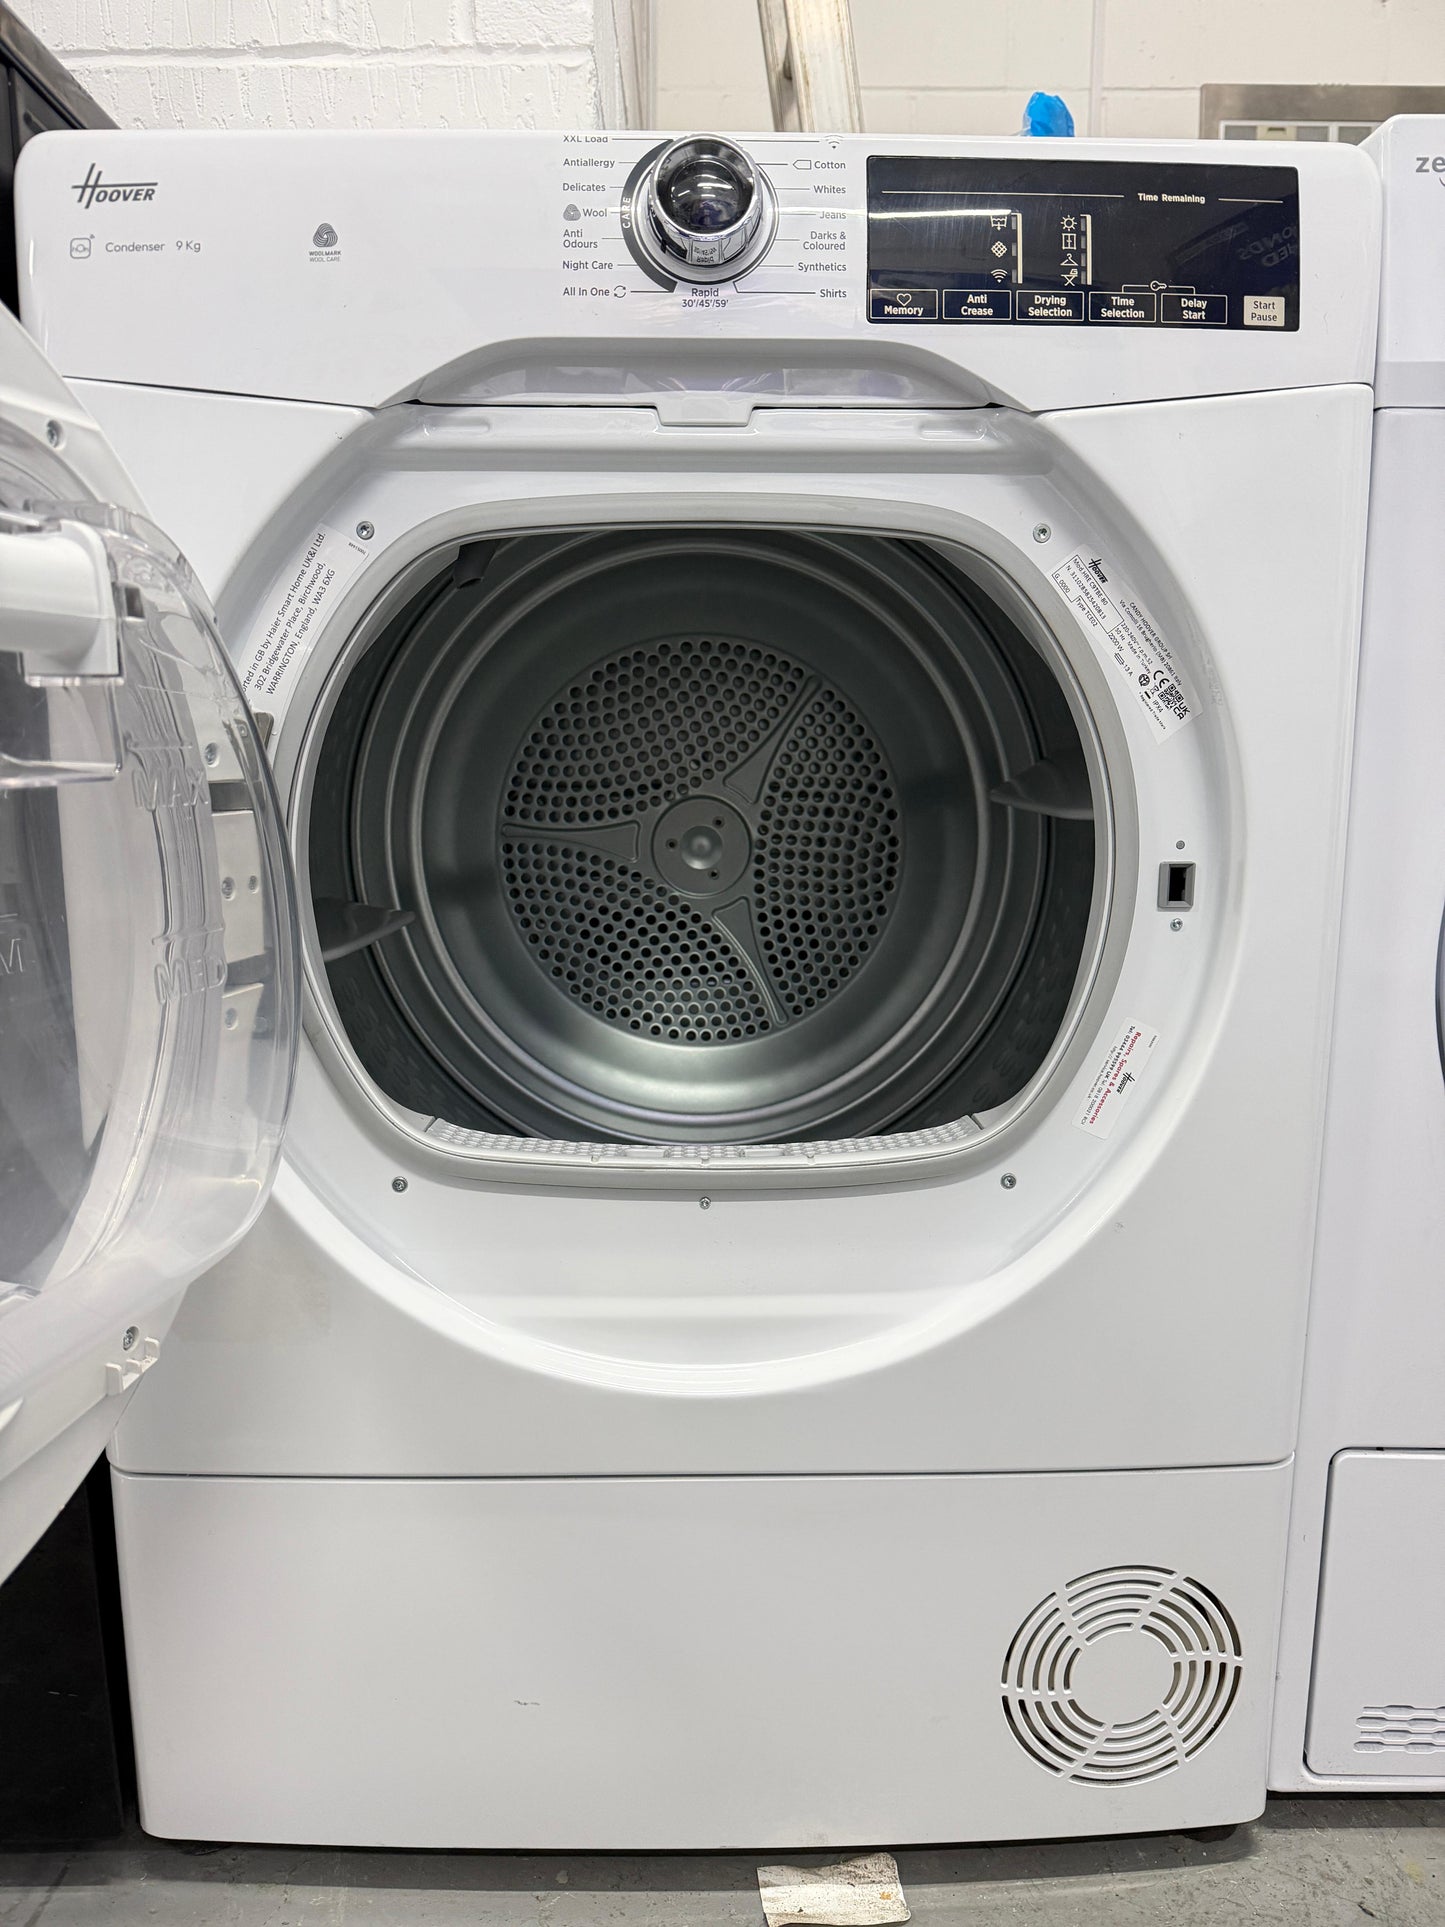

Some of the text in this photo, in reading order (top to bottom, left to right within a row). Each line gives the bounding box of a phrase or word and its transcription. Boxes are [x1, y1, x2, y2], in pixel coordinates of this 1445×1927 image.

[563, 134, 609, 143] XXL Load
[563, 157, 615, 169] Antiallergy
[814, 160, 846, 170] Cotton
[71, 163, 158, 209] HOOVER
[562, 182, 606, 193] Delicates
[813, 184, 846, 195] Whites
[1138, 192, 1206, 205] Time Remaining
[582, 207, 608, 218] Wool
[621, 196, 631, 229] CARE
[819, 210, 847, 220] Jeans
[563, 229, 583, 239] Anti
[810, 230, 847, 240] Darks &
[105, 241, 166, 253] Condenser
[175, 240, 201, 253] 9 Kg
[563, 239, 598, 249] Odours
[803, 240, 846, 251] Coloured
[562, 260, 614, 271] Night Care
[798, 261, 847, 273] Synthetics
[562, 287, 610, 297] All In One
[691, 287, 720, 299] Rapid
[820, 288, 847, 299] Shirts
[681, 299, 729, 309] 30'/45'/59'
[966, 294, 988, 305] Anti
[1034, 295, 1067, 309] Drying
[1111, 296, 1135, 307] Time
[1181, 298, 1208, 311] Delay
[1253, 300, 1276, 311] Start
[883, 304, 924, 318] Memory
[960, 305, 994, 317] Crease
[1028, 306, 1073, 318] Selection
[1100, 307, 1145, 319] Selection
[1182, 310, 1206, 321] Start
[1250, 311, 1278, 323] Pause
[249, 662, 259, 671] in
[254, 649, 265, 662] GB
[260, 638, 271, 649] by
[266, 617, 281, 639] Haier
[277, 593, 294, 617] Smart
[289, 569, 307, 593] Home
[302, 546, 318, 568] UK&I
[313, 532, 326, 547] Ltd.
[1075, 597, 1098, 627] Type TCE02
[254, 562, 326, 691] 302 Bridgewater Place, Birchwood,
[265, 568, 335, 694] WARRINGTON, England, WA3 6XG
[1107, 632, 1120, 646] 2200
[1172, 706, 1185, 720] CA
[1178, 701, 1190, 715] UK
[132, 768, 210, 811] MAX
[154, 954, 228, 1005] MED
[1123, 1031, 1142, 1057] Repairs,
[1104, 1070, 1112, 1079] UK
[1111, 1058, 1127, 1080] Spares
[1089, 1087, 1111, 1124] Accessories
